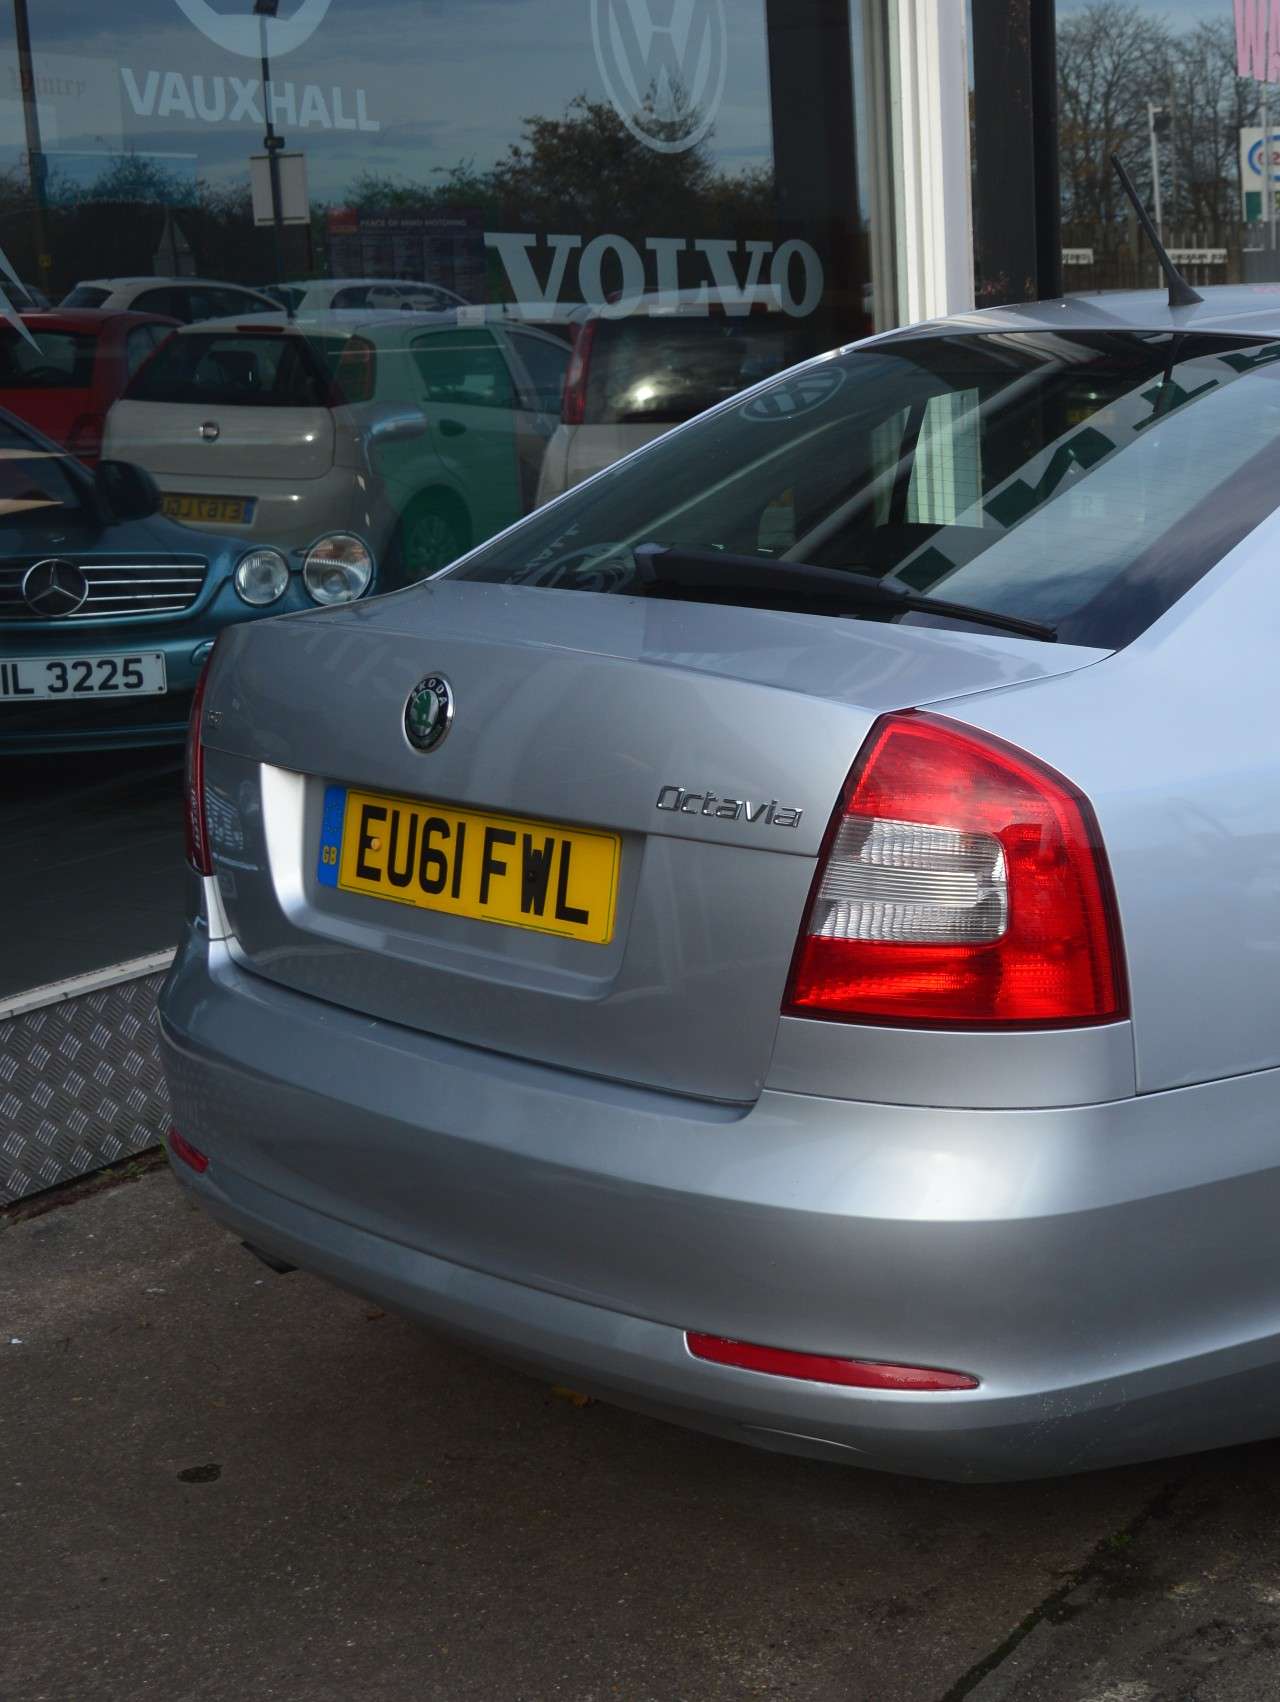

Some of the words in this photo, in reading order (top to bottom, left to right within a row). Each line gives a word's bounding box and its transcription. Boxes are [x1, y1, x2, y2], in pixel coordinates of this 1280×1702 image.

[120, 67, 380, 132] VAUXHALL
[484, 231, 824, 320] VOLVO
[1, 663, 35, 695] IL
[46, 657, 144, 693] 3225
[656, 785, 804, 828] Octavia
[322, 846, 337, 865] GB
[356, 804, 467, 899] EU61
[479, 826, 589, 925] FWL
